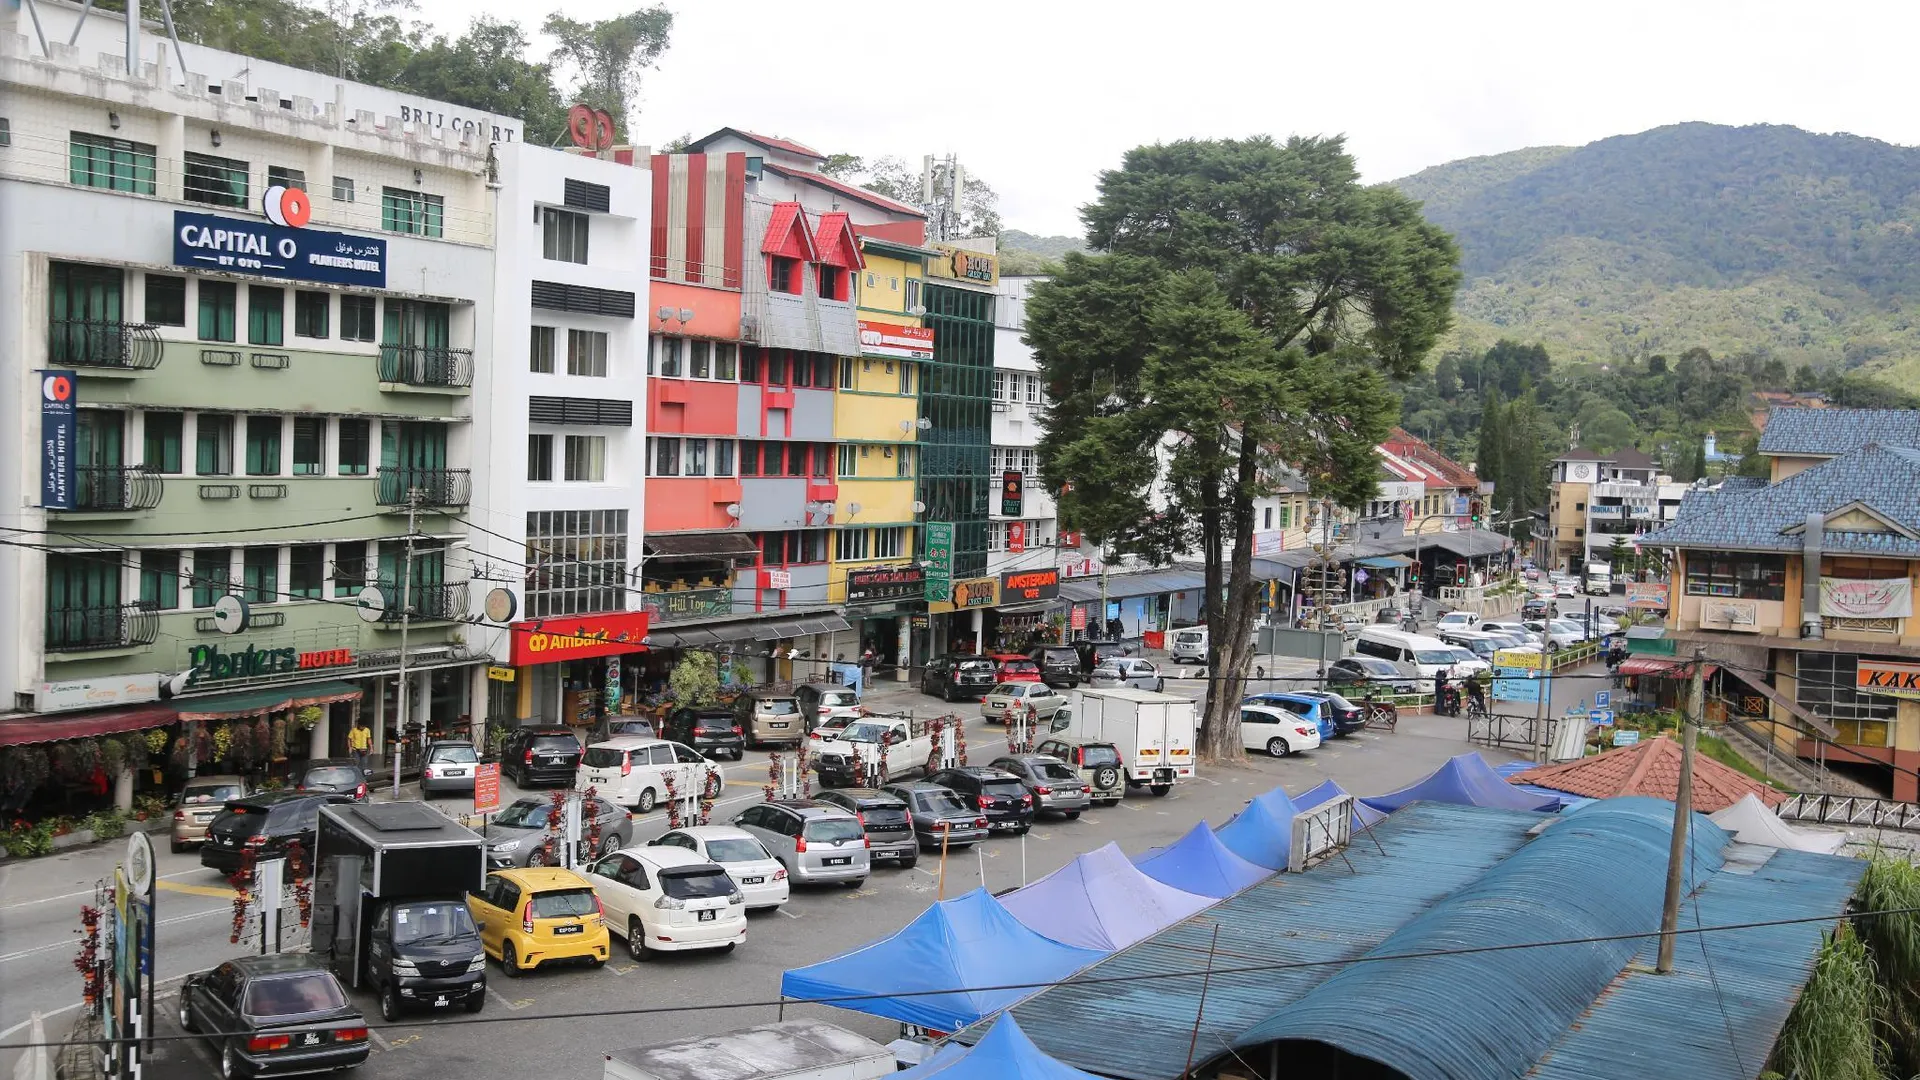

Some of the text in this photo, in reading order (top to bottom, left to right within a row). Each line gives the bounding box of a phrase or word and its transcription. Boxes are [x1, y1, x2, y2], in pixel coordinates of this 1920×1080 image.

[401, 105, 443, 129] BRIJ
[181, 225, 297, 259] CAPITAL O
[219, 255, 262, 269] BY OYO
[309, 253, 381, 273] PLANTERS HOTEL
[57, 424, 66, 453] HOTEL
[57, 456, 66, 502] PLANTERS
[1007, 572, 1057, 588] AMSTERDAM
[668, 594, 706, 612] Hill Top
[1024, 589, 1040, 599] CAFE
[188, 643, 353, 686] Planters HOTEL
